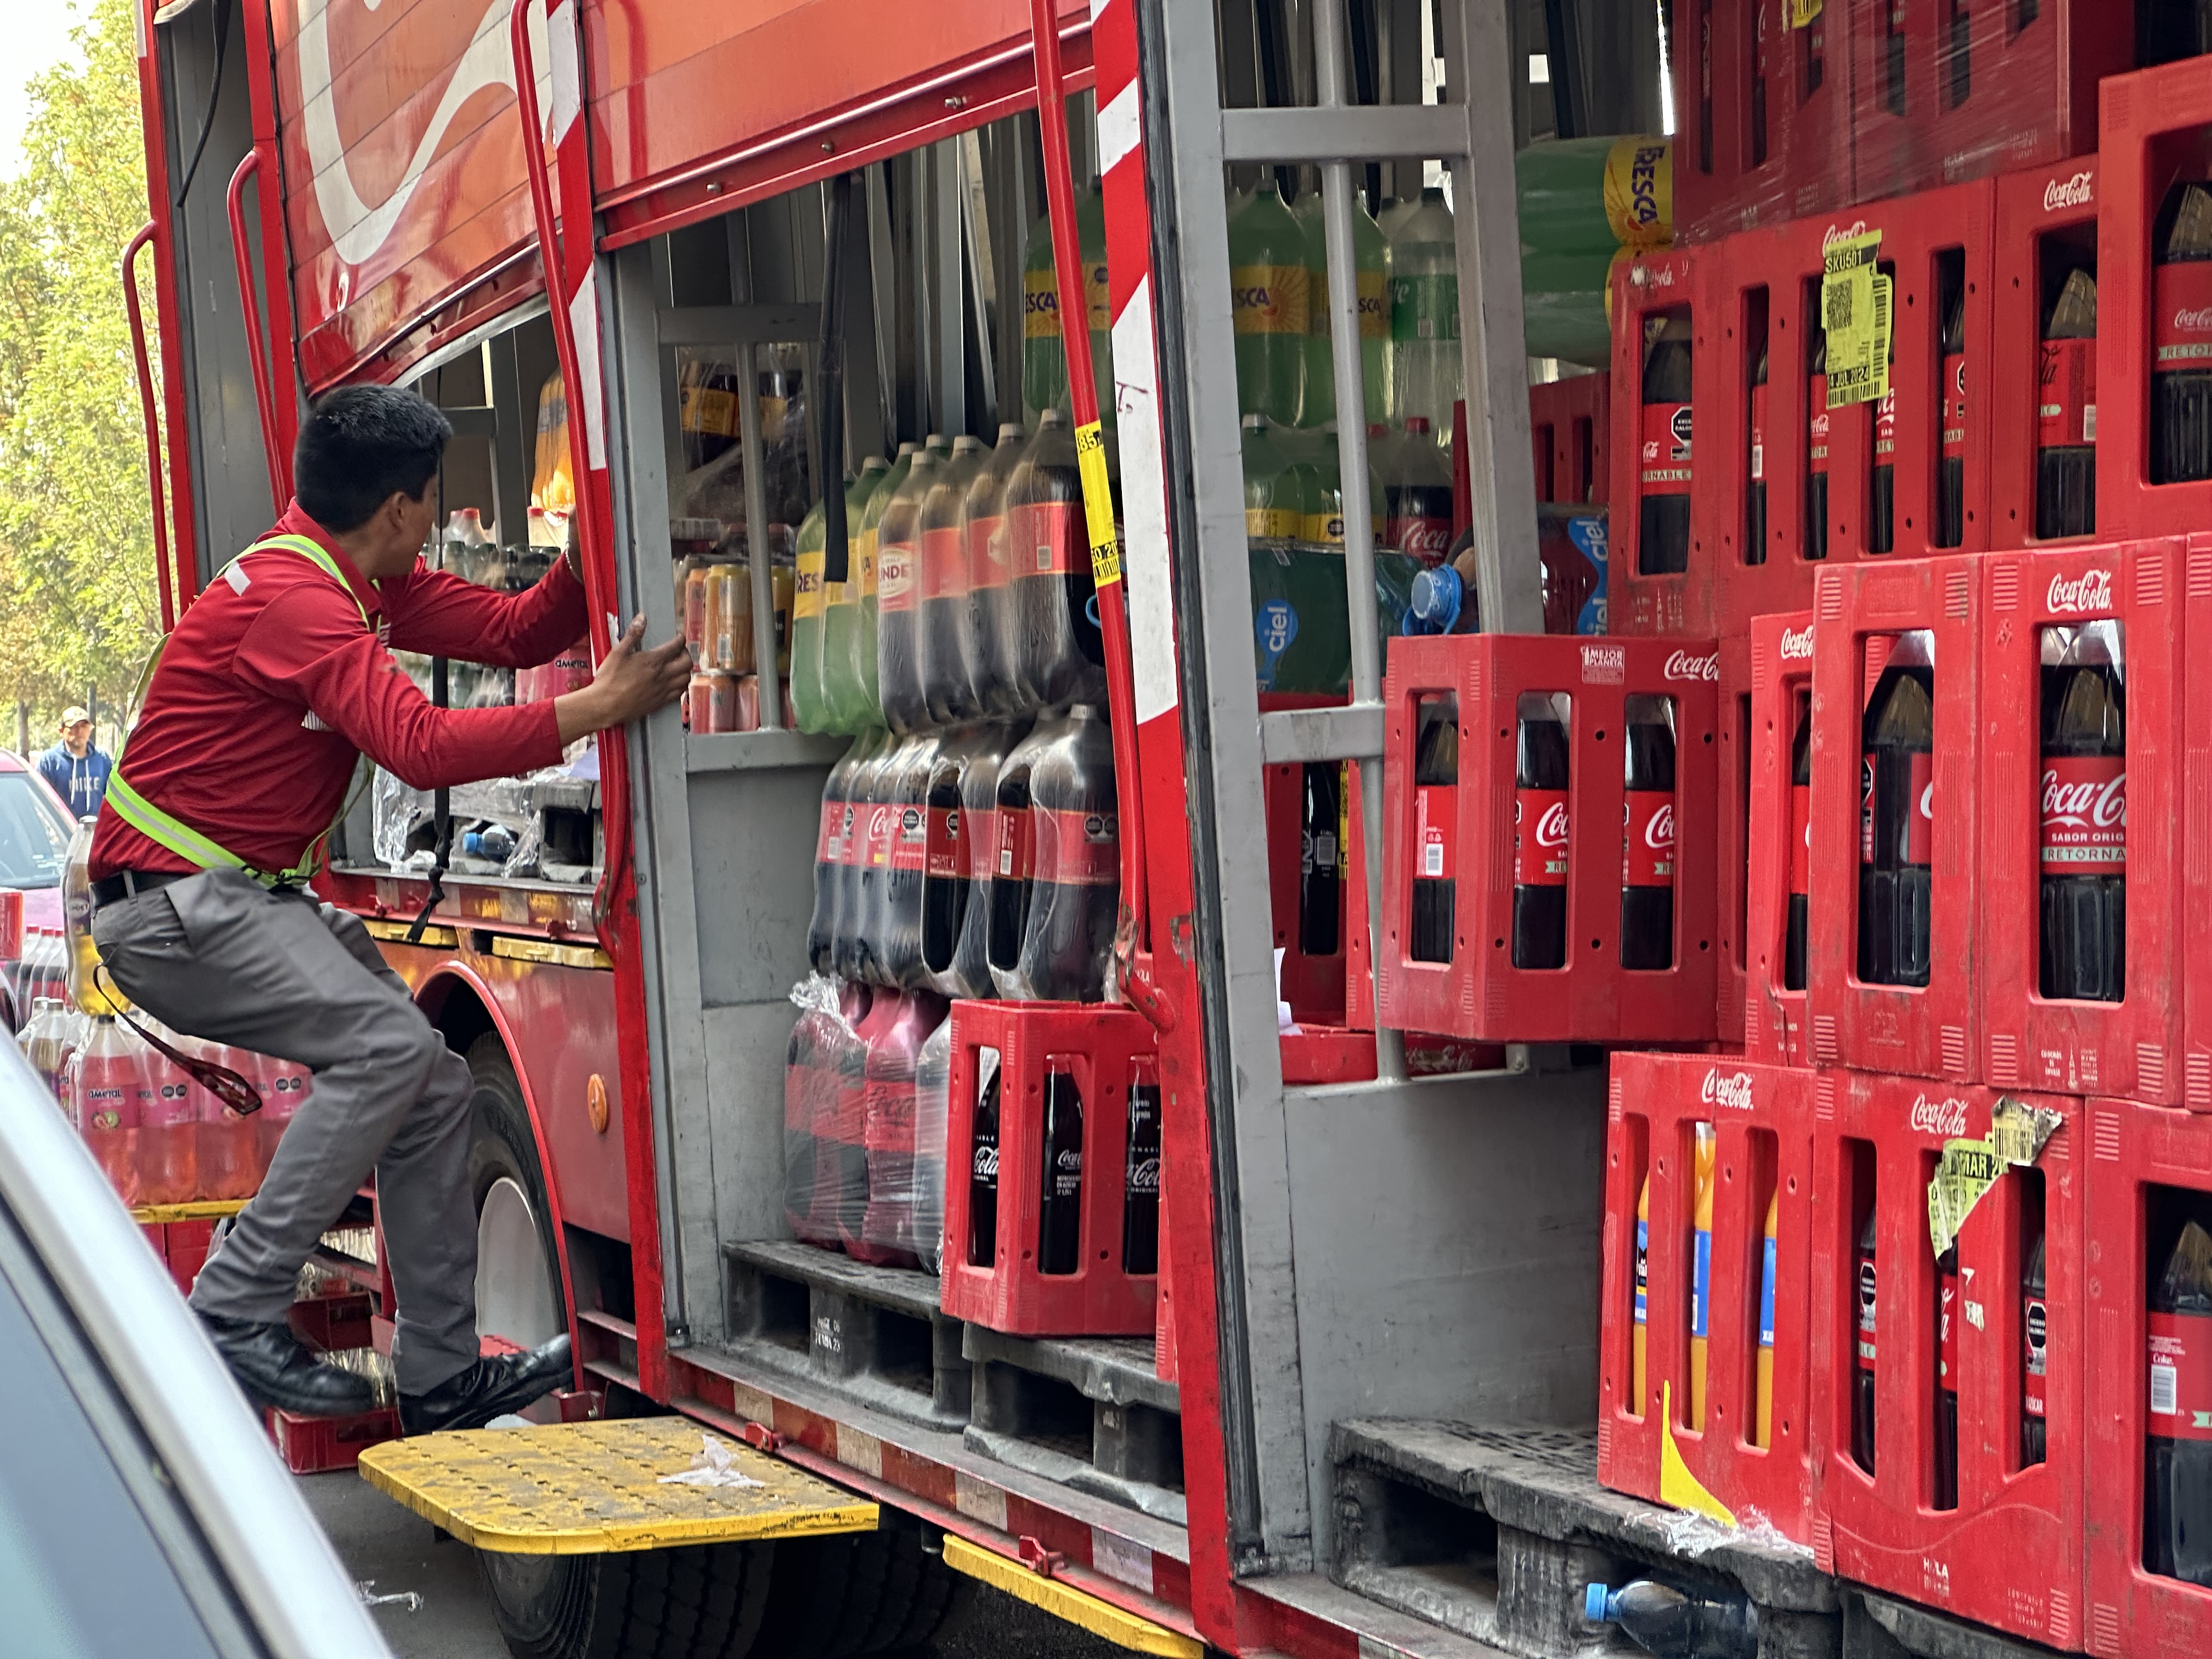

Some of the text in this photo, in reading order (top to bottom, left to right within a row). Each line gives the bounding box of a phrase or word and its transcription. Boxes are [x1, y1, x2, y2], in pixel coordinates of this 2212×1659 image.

[2047, 569, 2113, 613] Coca-Cola
[1267, 606, 1288, 653] Ciel
[1589, 658, 1623, 668] PLANETA
[1590, 648, 1623, 659] MEJOR
[2051, 832, 2087, 843] SABOR
[2048, 848, 2126, 861] RETORNA
[1701, 1067, 1754, 1110] Coca-Cola
[1911, 1092, 1969, 1137] Coca-Cola
[1923, 1557, 1949, 1578] HLA
